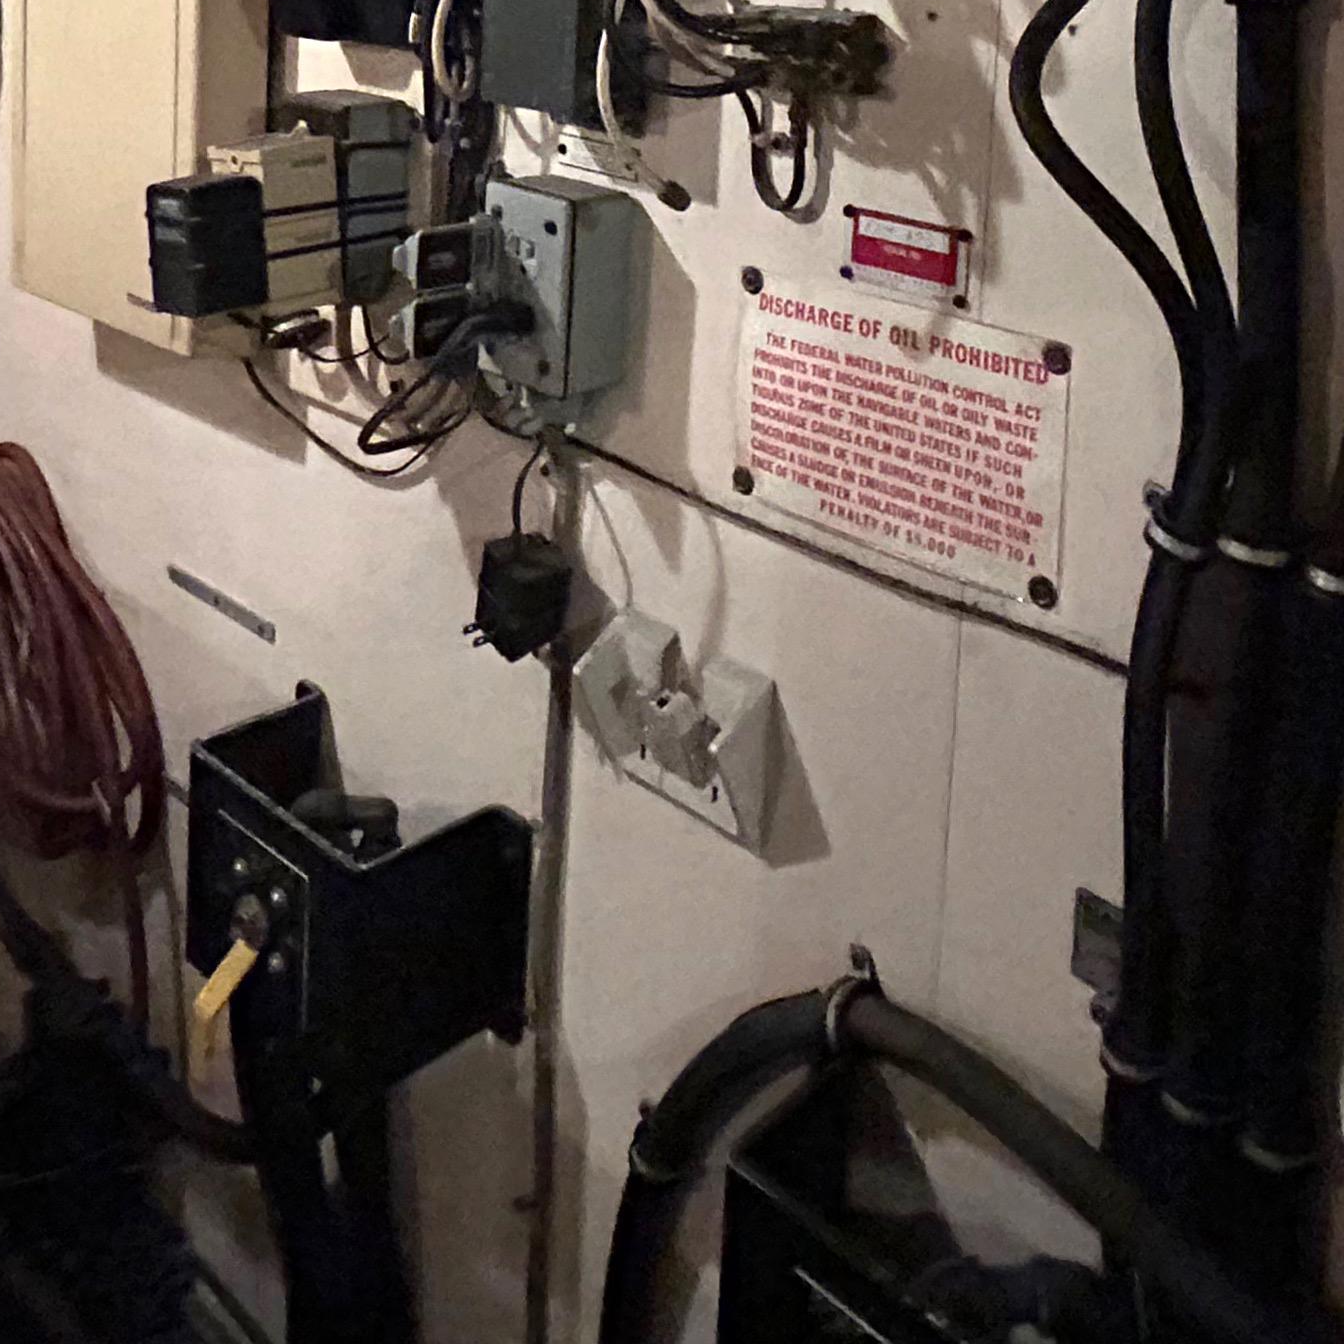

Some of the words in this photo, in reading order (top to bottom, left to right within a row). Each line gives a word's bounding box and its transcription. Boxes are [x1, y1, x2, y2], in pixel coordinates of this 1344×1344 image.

[759, 293, 854, 333] DISCHARGE
[859, 318, 882, 339] OF
[890, 325, 920, 351] OIL
[929, 335, 1048, 385] PROHIBITED
[766, 331, 787, 349] THE
[790, 339, 840, 364] FEDERAL
[844, 353, 883, 375] WATER
[886, 364, 949, 393] POLLUTION
[953, 385, 1008, 413] CONTROL
[1015, 403, 1041, 422] ACT
[753, 366, 776, 384] INTO
[780, 375, 794, 389] OR
[798, 379, 827, 397] UPON
[832, 388, 853, 405] THE
[858, 395, 919, 425] NAVIGABLE
[924, 415, 972, 442] WATERS
[975, 430, 1001, 451] AND
[755, 348, 807, 374] PROHIBITS
[811, 363, 833, 381] THE
[835, 370, 898, 399] DISCHARGE
[902, 389, 916, 404] OF
[919, 394, 938, 411] OIL
[942, 401, 959, 417] OR
[961, 408, 988, 428] OILY
[994, 417, 1038, 442] WASTE
[798, 397, 825, 416] ZONE
[829, 407, 845, 420] OF
[849, 412, 871, 430] THE
[874, 420, 916, 444] UNITED
[919, 433, 962, 458] STATES
[966, 448, 978, 463] IF
[984, 455, 1022, 478] SUCH
[751, 402, 808, 430] DISCHARGE
[811, 420, 853, 443] CAUSES
[864, 436, 893, 454] FILM
[895, 445, 912, 461] OR
[913, 451, 951, 474] SHEEN
[1006, 482, 1025, 500] OR
[798, 454, 838, 478] SLUDGE
[841, 468, 856, 483] OR
[859, 474, 916, 503] EMULSION
[919, 494, 973, 524] BENEATH
[977, 513, 1001, 534] THE
[853, 452, 875, 470] THE
[878, 460, 927, 488] SURFACE
[931, 478, 947, 493] OF
[952, 484, 974, 504] THE
[1026, 511, 1043, 527] OR
[791, 470, 810, 487] THE
[858, 491, 920, 524] VIOLATORS
[923, 515, 946, 534] ARE
[949, 525, 1001, 554] SUBJECT
[1006, 543, 1024, 562] TO
[1027, 553, 1036, 567] A
[820, 499, 879, 529] PENALTY
[883, 521, 901, 538] OF
